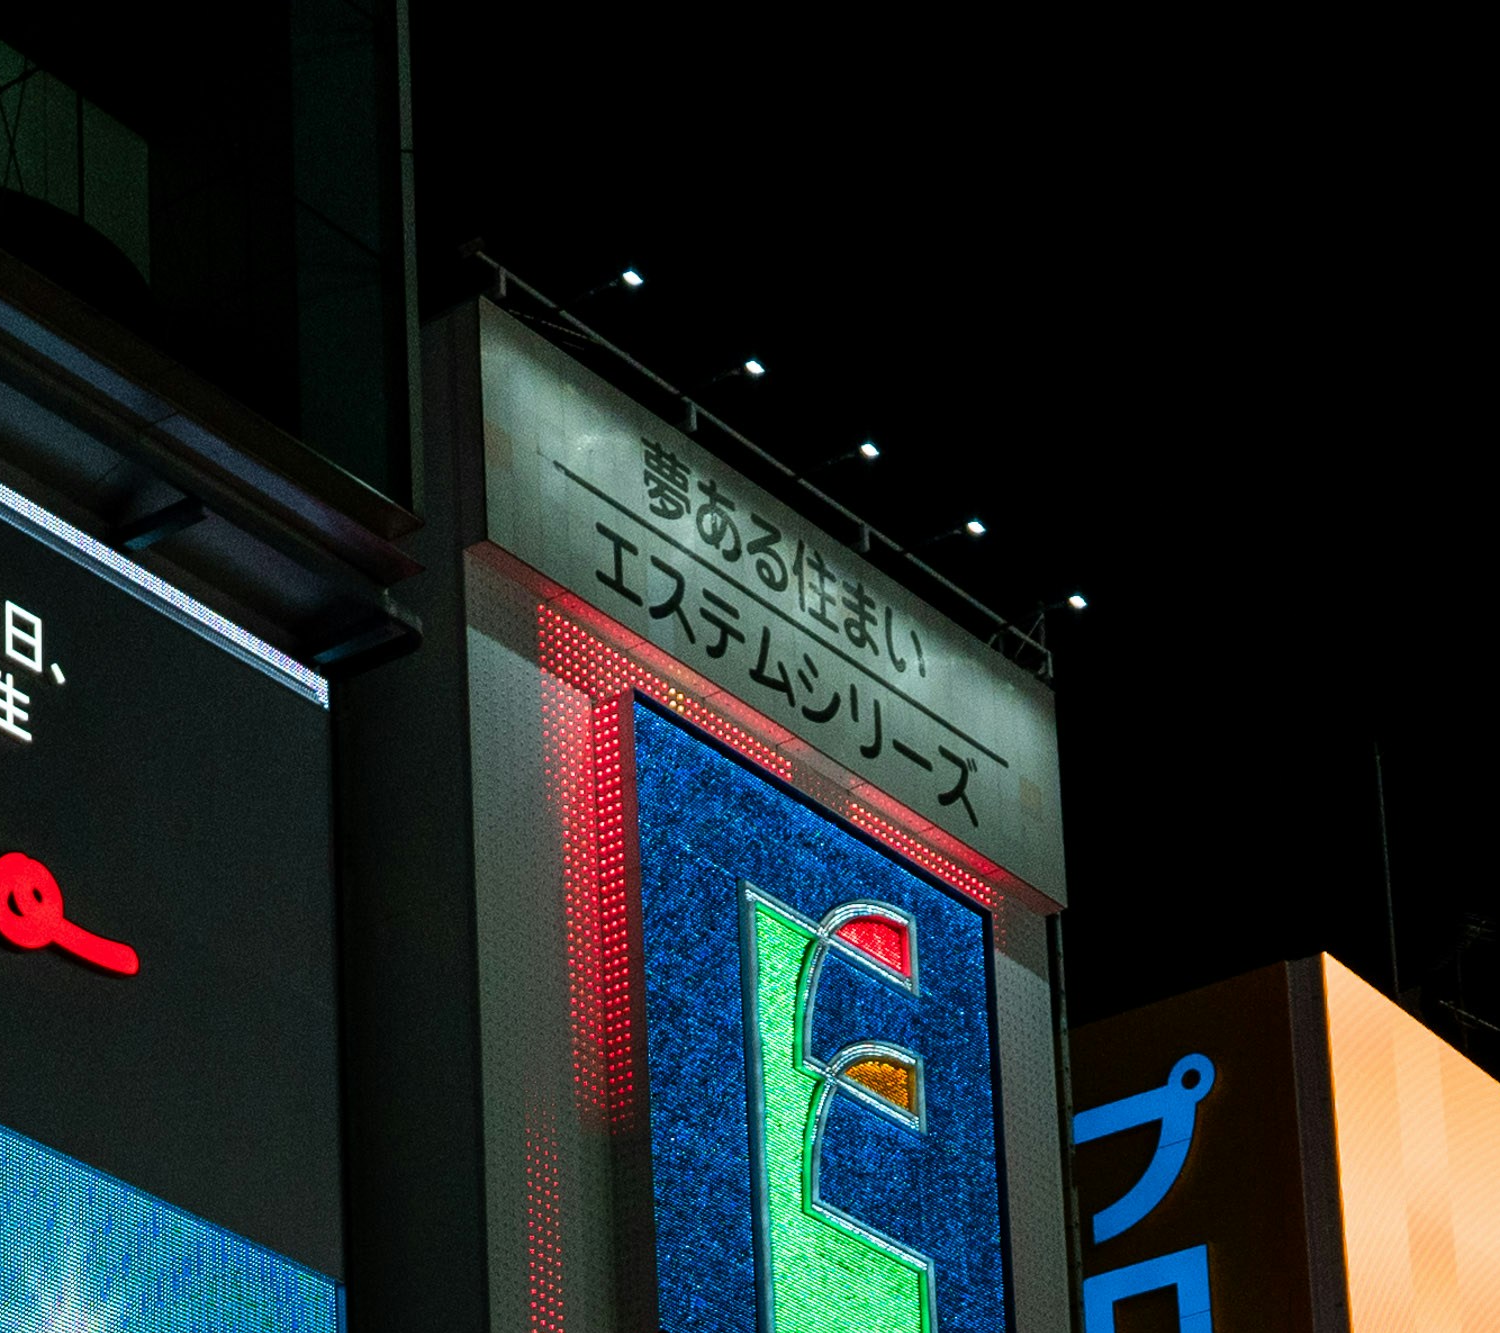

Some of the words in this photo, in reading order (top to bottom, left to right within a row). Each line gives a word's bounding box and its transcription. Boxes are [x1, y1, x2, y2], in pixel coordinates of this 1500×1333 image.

[595, 521, 979, 829] エステムシリーズ
[639, 434, 927, 679] 夢ある住まい
